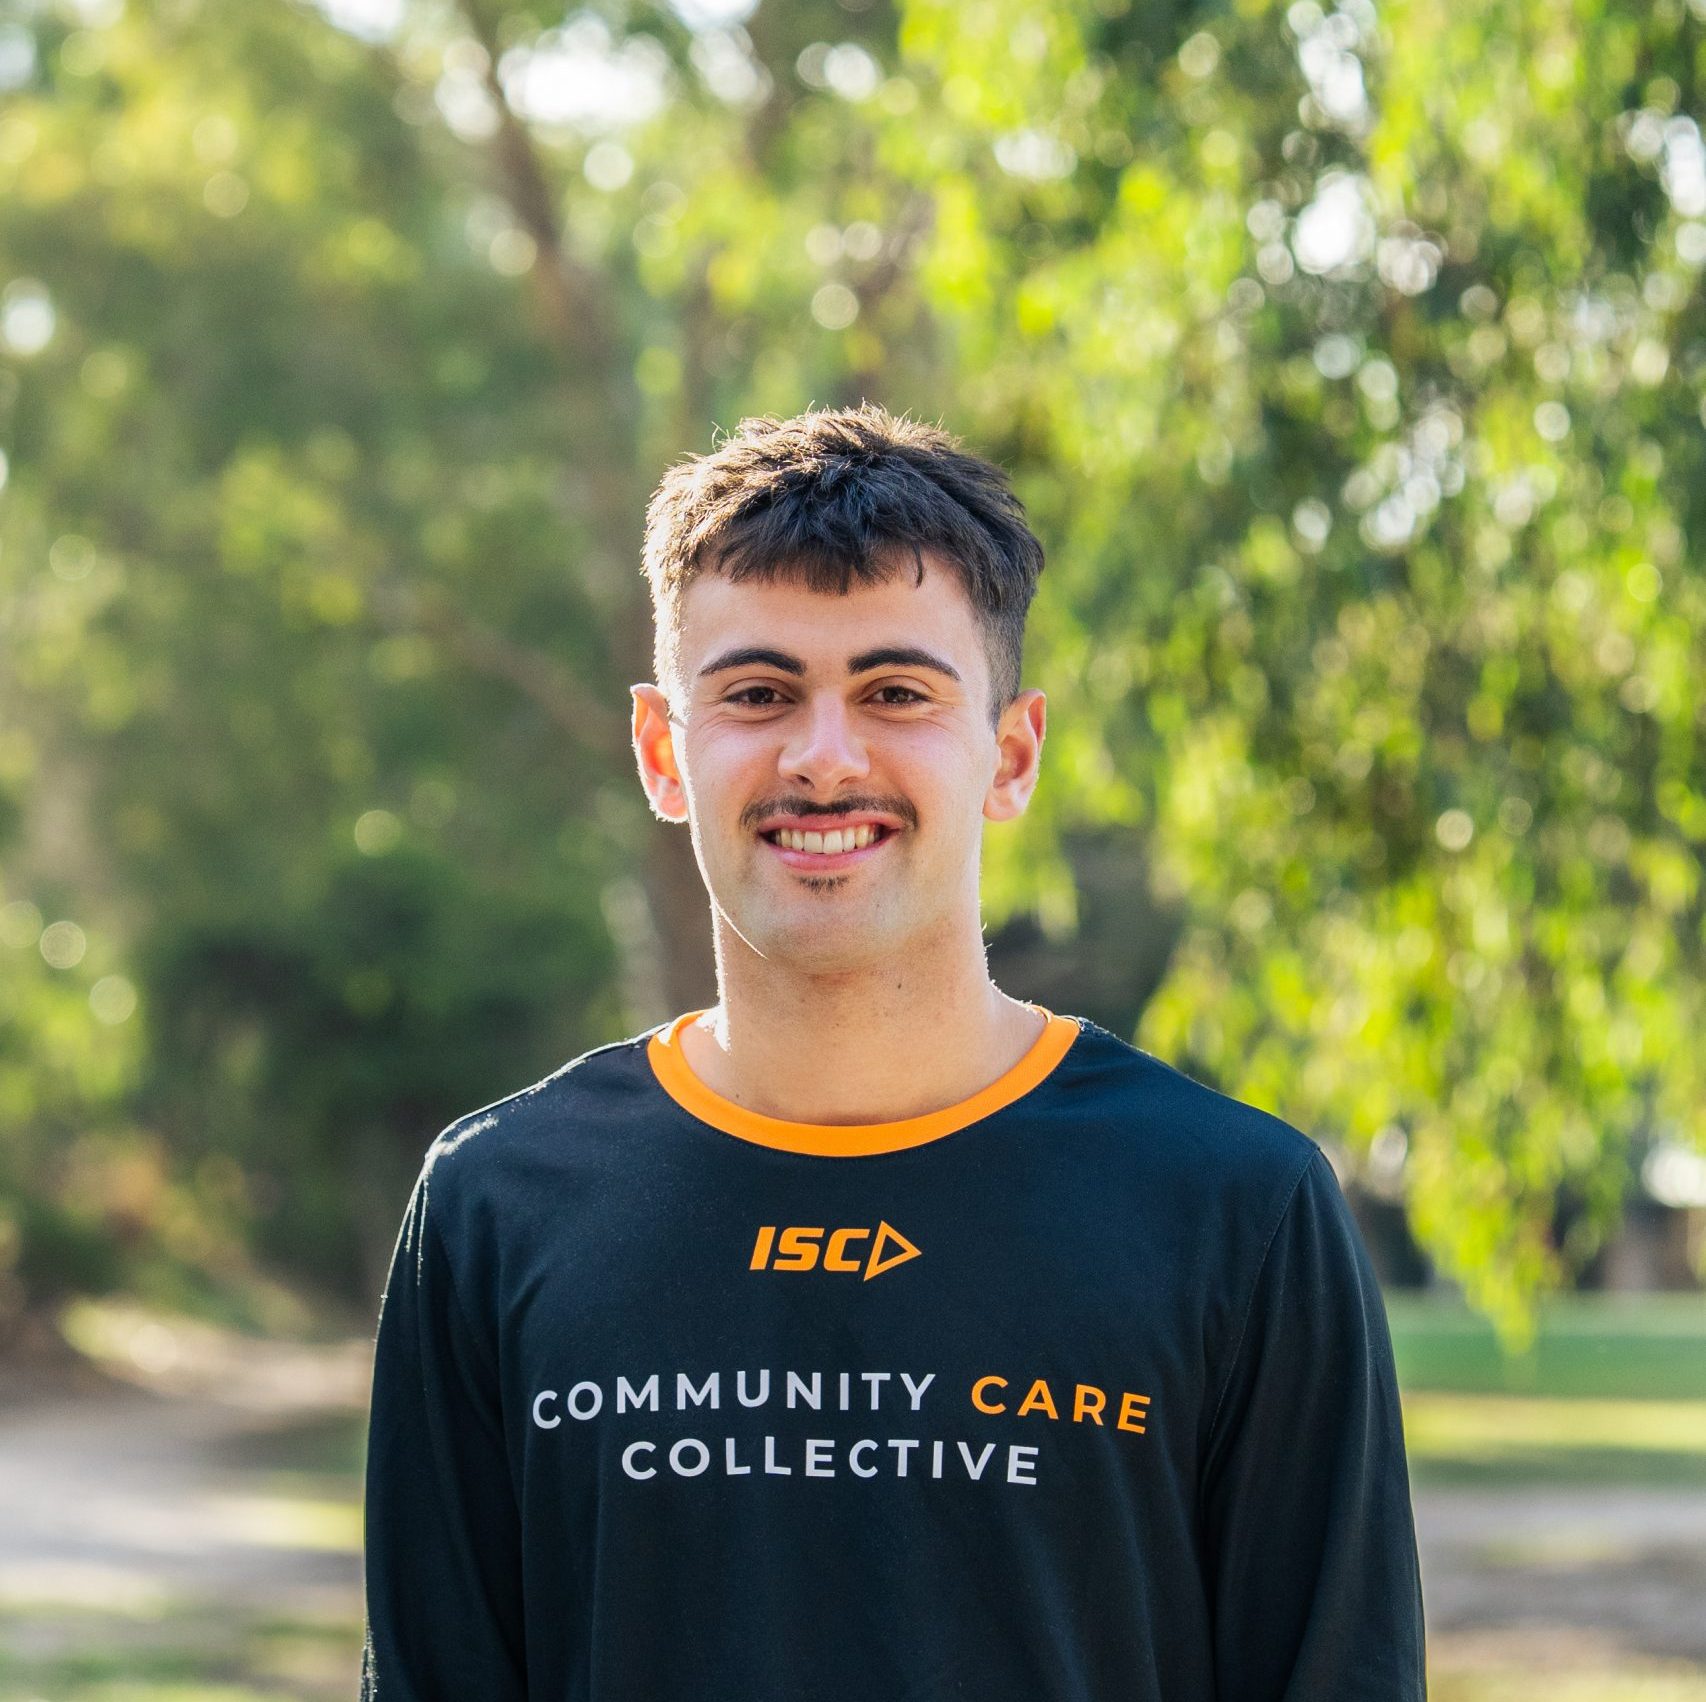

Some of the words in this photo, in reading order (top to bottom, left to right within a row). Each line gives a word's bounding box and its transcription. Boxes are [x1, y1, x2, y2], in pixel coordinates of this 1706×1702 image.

[749, 1226, 871, 1272] ISC
[532, 1368, 937, 1430] COMMUNITY
[970, 1375, 1152, 1435] CARE
[621, 1435, 1040, 1486] COLLECTIVE
